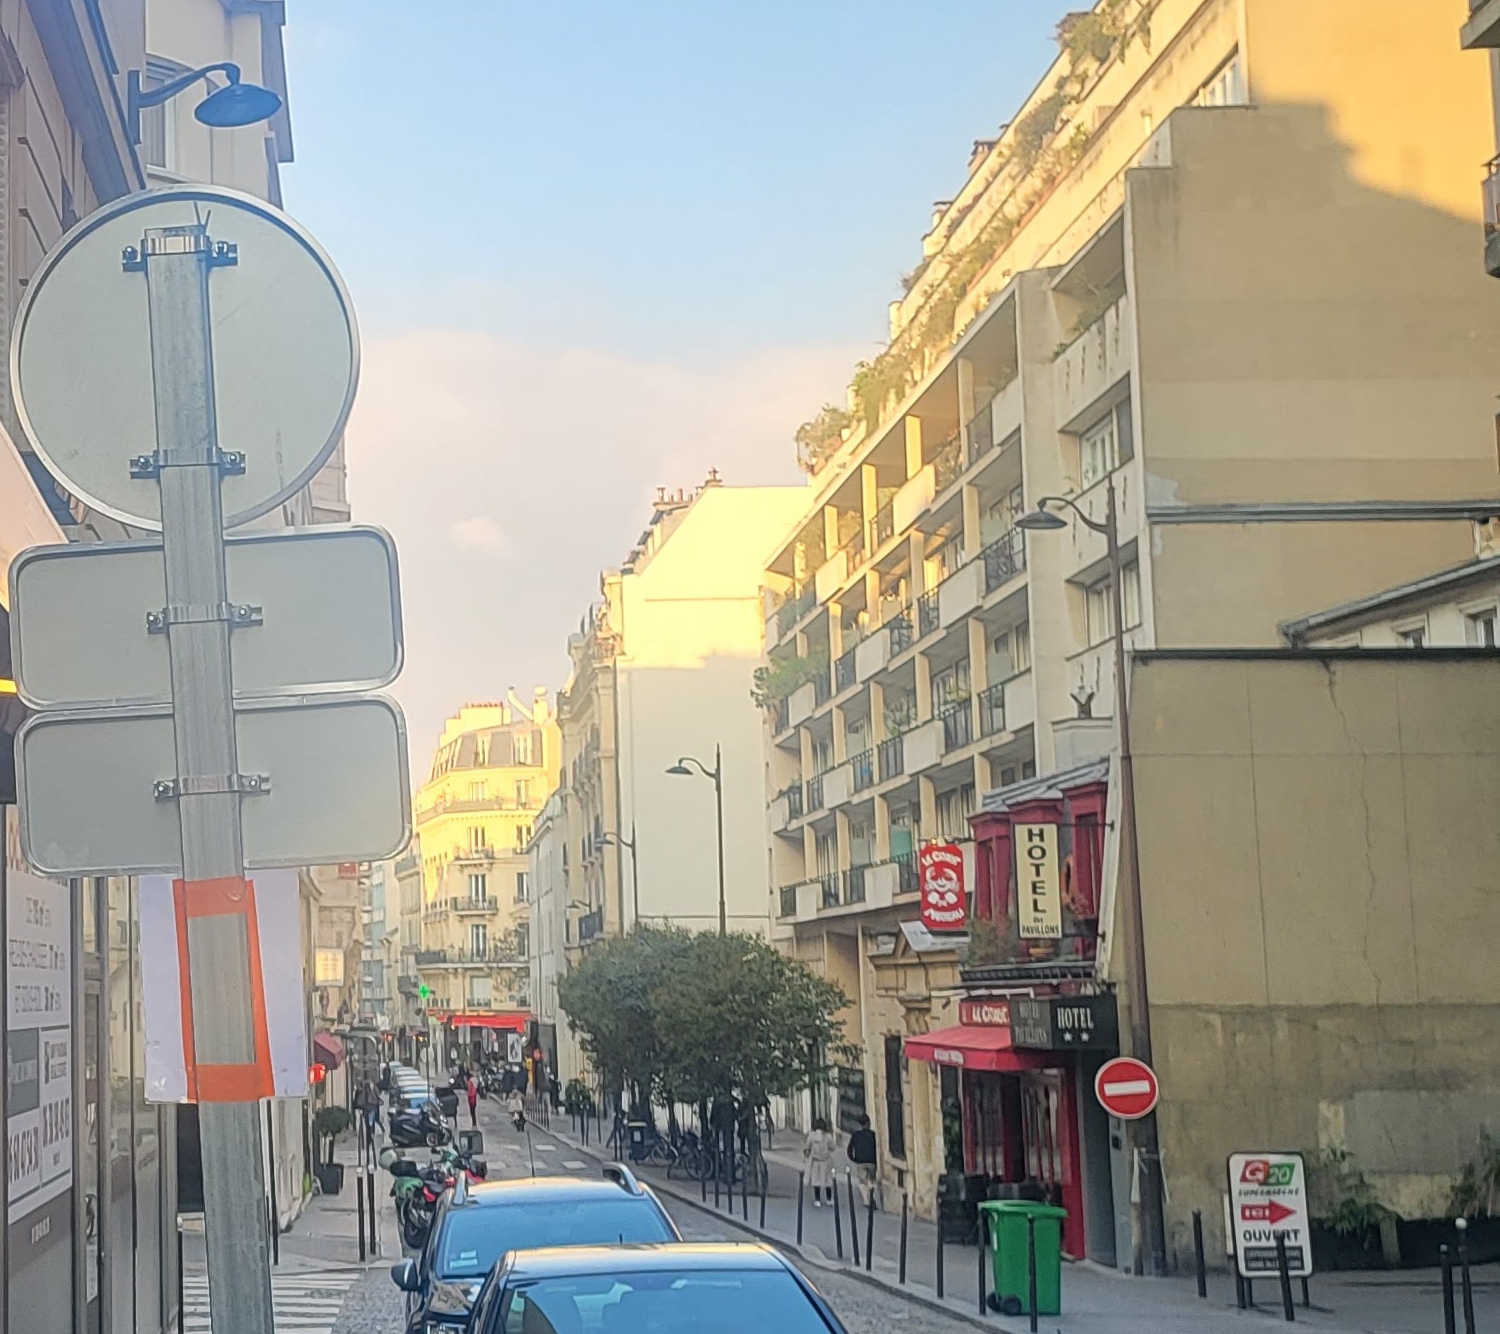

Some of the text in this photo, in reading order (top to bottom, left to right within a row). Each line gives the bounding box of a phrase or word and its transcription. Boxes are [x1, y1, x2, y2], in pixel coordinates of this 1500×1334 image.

[1026, 827, 1047, 914] HOTEL
[1056, 1007, 1094, 1030] HOTEL
[1245, 1162, 1290, 1183] G20
